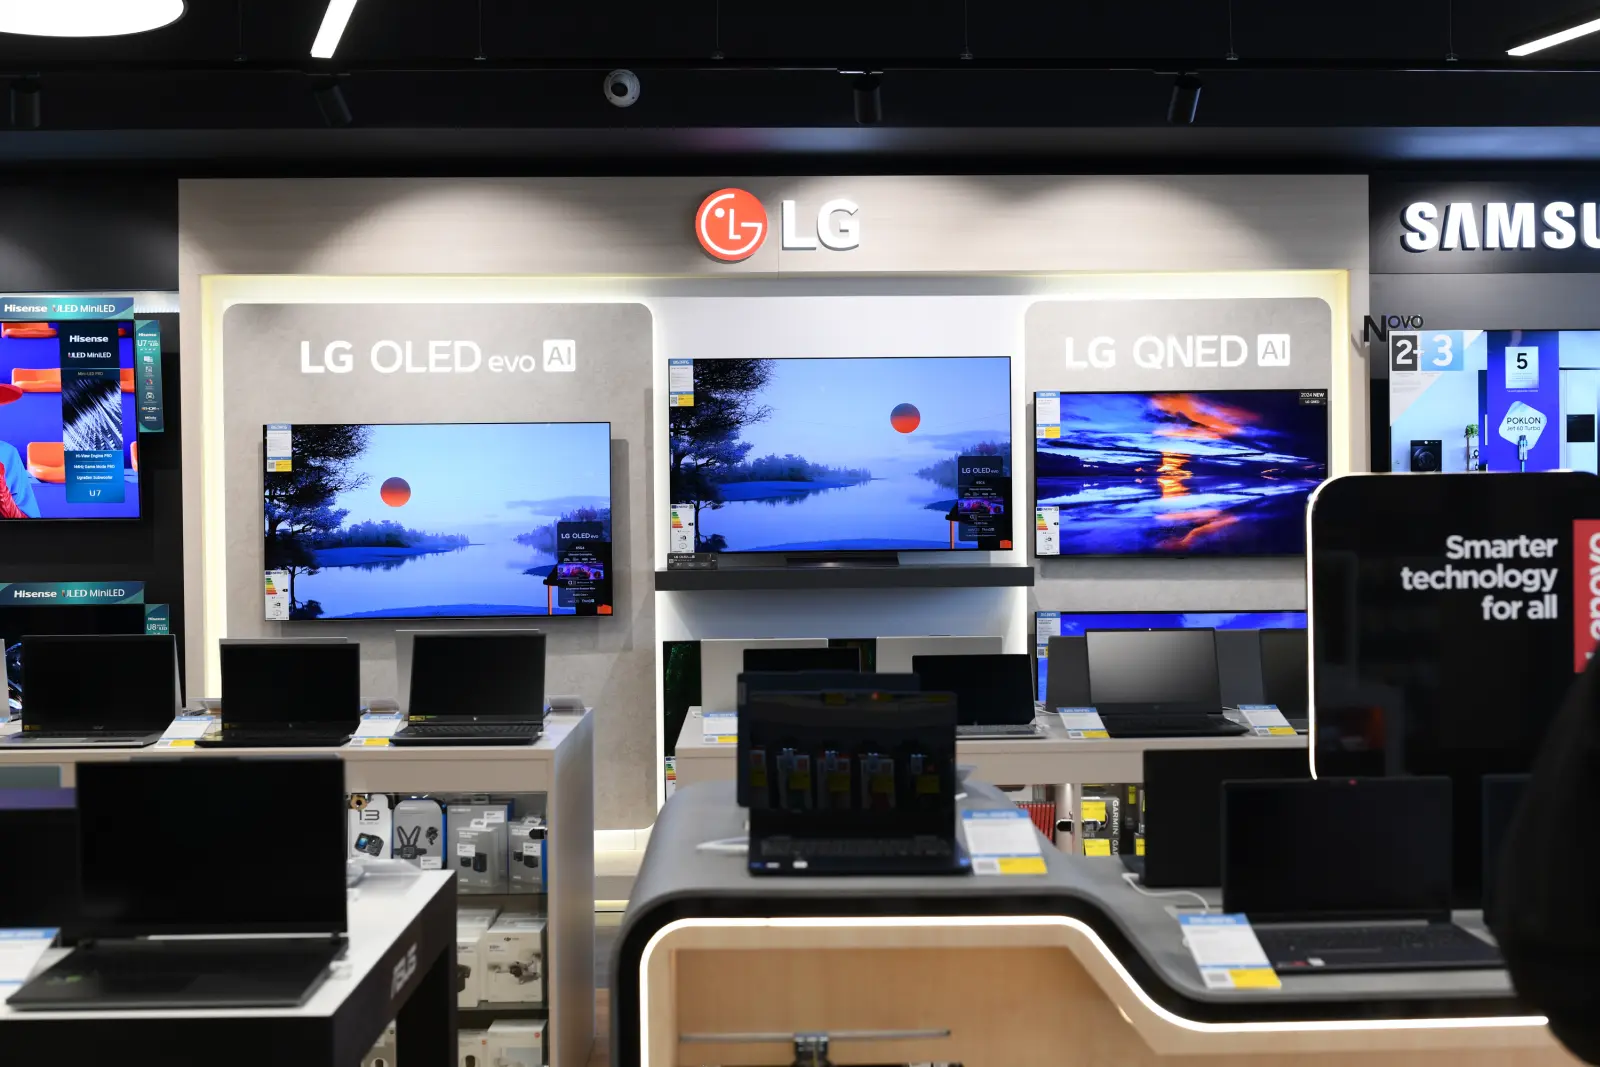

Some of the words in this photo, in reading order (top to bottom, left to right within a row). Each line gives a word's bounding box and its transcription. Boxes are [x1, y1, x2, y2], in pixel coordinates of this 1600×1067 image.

[781, 199, 860, 251] LG
[4, 304, 48, 313] Hisense
[80, 304, 115, 313] MiniLED
[69, 335, 109, 343] Hisense
[301, 340, 354, 374] LG
[370, 340, 482, 374] OLED
[488, 354, 536, 373] evo
[545, 344, 573, 369] AI
[1065, 336, 1117, 369] LG
[1132, 334, 1249, 370] QNED
[1260, 338, 1288, 363] AI
[1516, 352, 1528, 370] 5
[1507, 417, 1541, 425] POKLON
[89, 489, 102, 497] U7
[1446, 535, 1559, 559] Smarter
[1401, 563, 1559, 593] technology
[13, 590, 57, 598] Hisense
[62, 590, 87, 598] ULED
[89, 589, 125, 597] MiniLED
[1481, 595, 1523, 620] for
[1527, 594, 1558, 620] all
